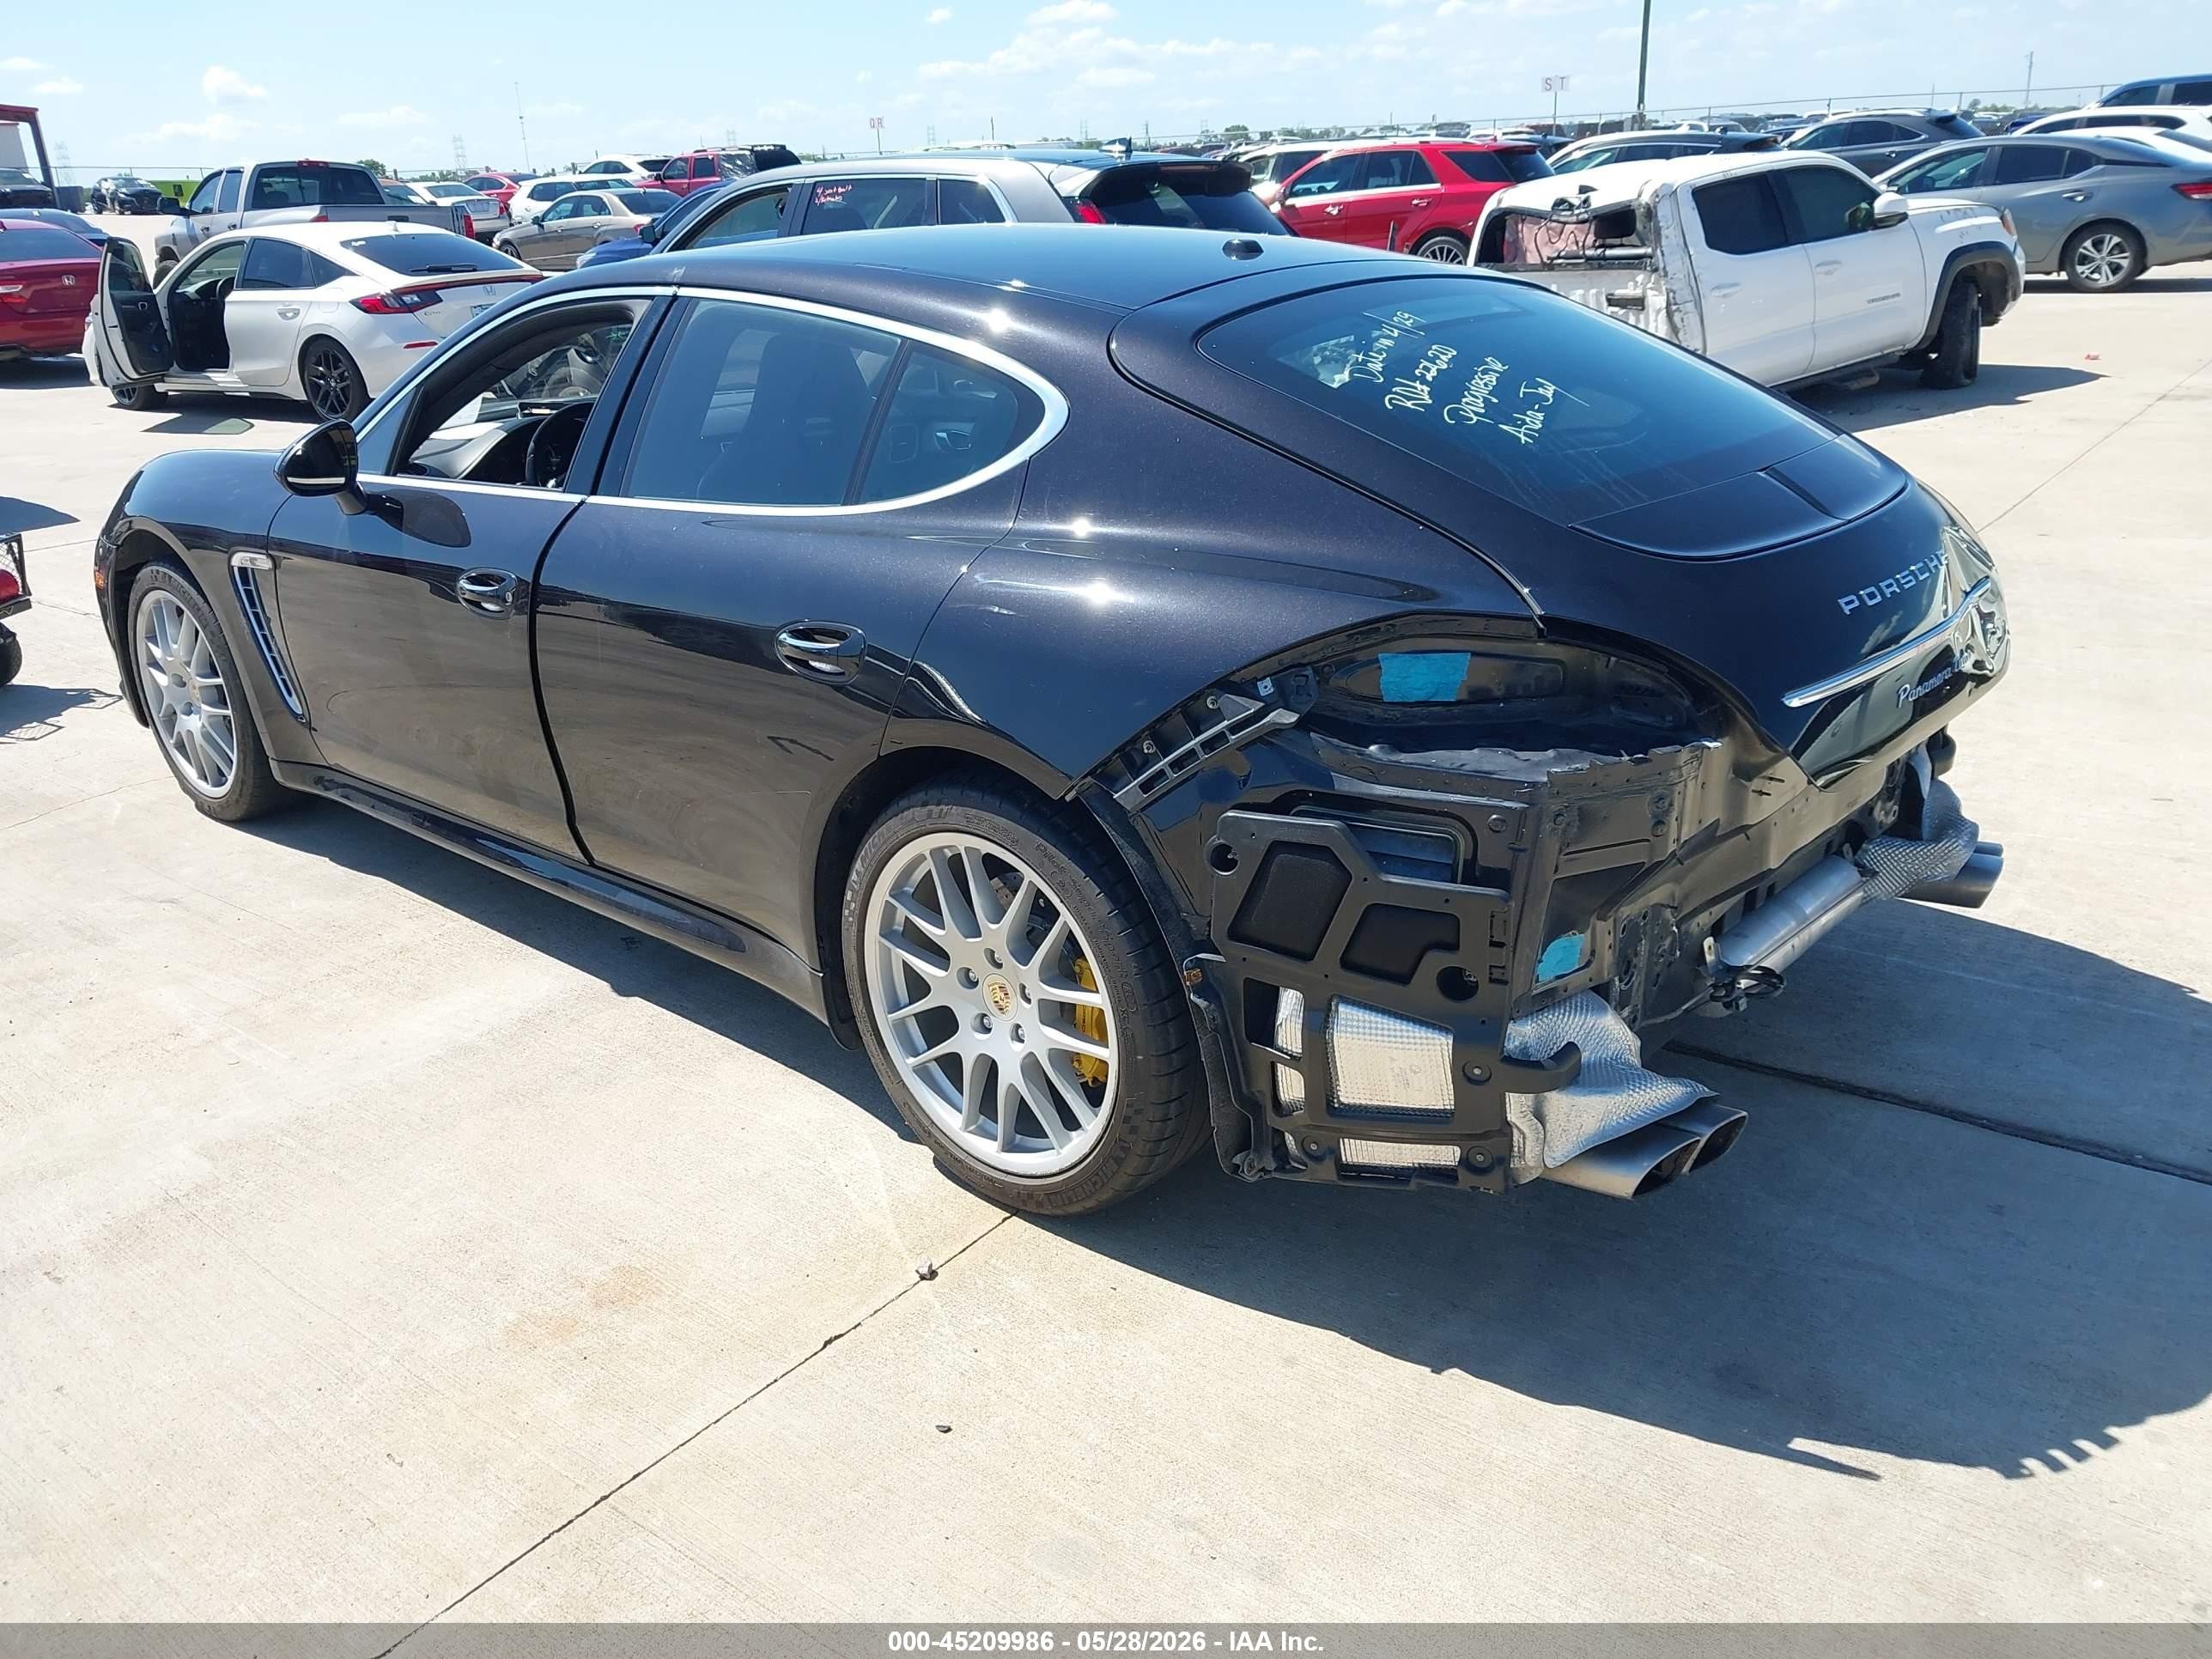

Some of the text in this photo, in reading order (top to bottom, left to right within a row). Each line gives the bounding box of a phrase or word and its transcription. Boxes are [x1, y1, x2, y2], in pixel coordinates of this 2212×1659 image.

[1443, 356, 1510, 424] Progressive
[1838, 550, 1948, 615] PORSCHE
[1896, 666, 1954, 709] Panamera
